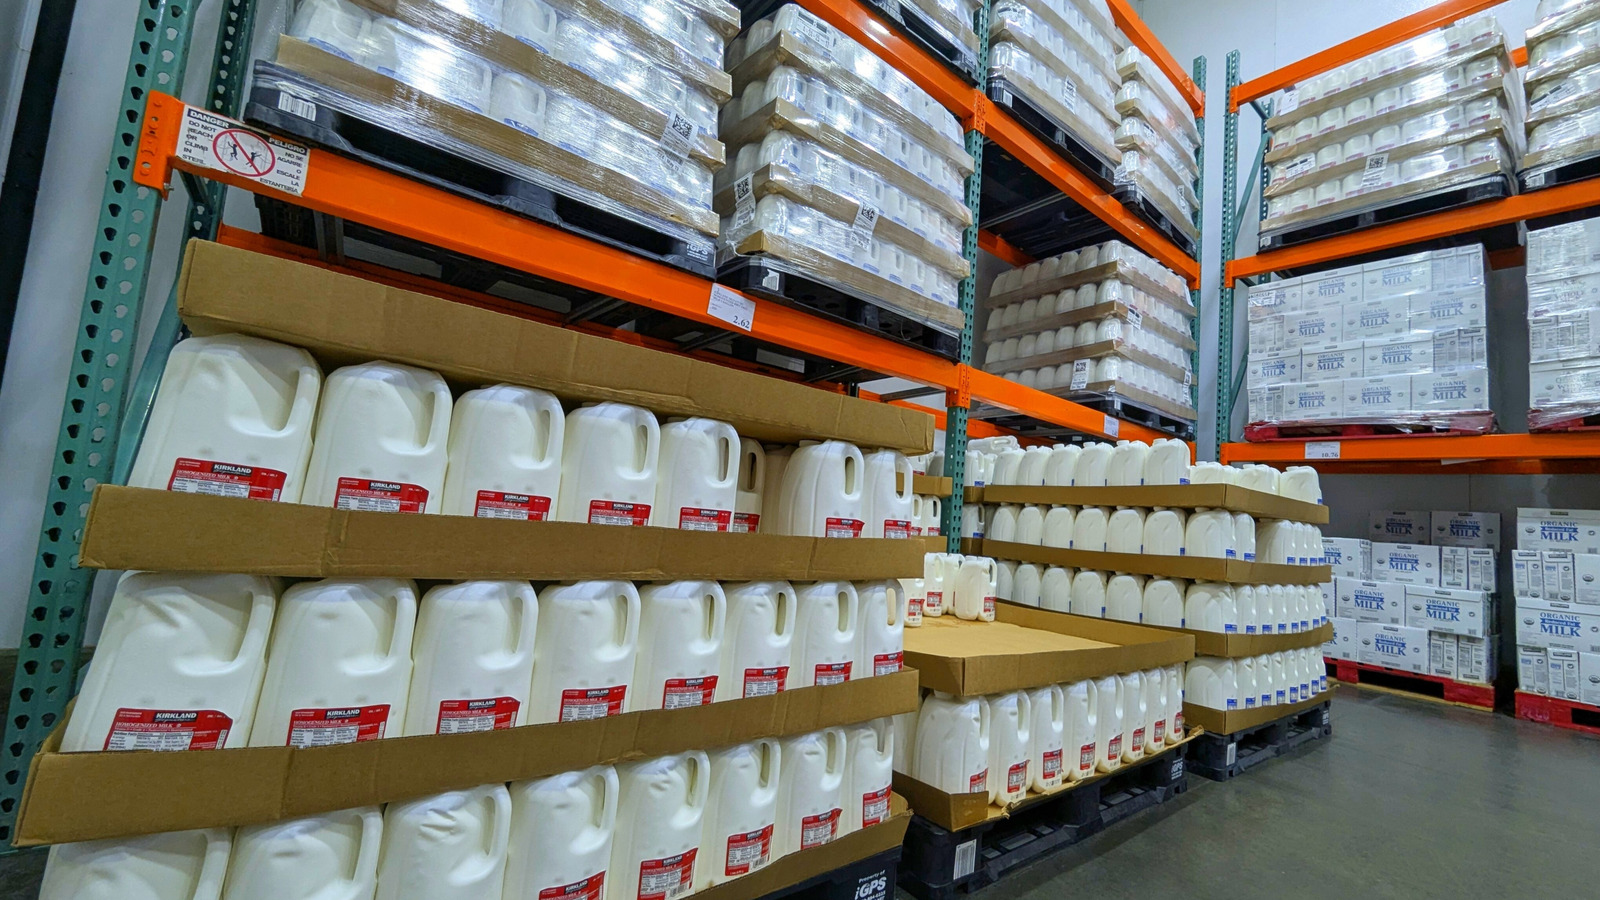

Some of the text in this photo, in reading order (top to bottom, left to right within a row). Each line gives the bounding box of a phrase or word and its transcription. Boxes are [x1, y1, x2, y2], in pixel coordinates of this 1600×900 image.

[190, 110, 230, 129] DANGER
[188, 120, 217, 133] DO NOT
[186, 134, 198, 142] OR
[187, 127, 213, 139] REACH
[184, 140, 209, 152] CLIMB
[268, 137, 307, 154] PELIGRO
[277, 156, 303, 168] AGARRE
[285, 151, 304, 162] NO SE
[276, 169, 301, 181] ESCALE
[1382, 275, 1412, 287] MILK
[1318, 286, 1345, 298] MILK
[1430, 308, 1464, 319] MILK
[733, 315, 750, 329] 2.62
[1360, 317, 1390, 328] MILK
[1299, 326, 1326, 337] MILK
[1382, 354, 1413, 365] MILK
[1317, 361, 1345, 371] MILK
[1261, 368, 1286, 378] MILK
[1361, 395, 1392, 405] MILK
[1432, 391, 1467, 401] MILK
[1298, 399, 1325, 409] MILK
[214, 463, 252, 474] KIRKLAND
[370, 482, 401, 490] KIRKLAND
[1385, 527, 1413, 535] MILK
[1449, 529, 1480, 537] MILK
[1540, 531, 1578, 541] MILK
[1324, 556, 1342, 565] ILK
[1389, 562, 1419, 571] MILK
[1354, 589, 1384, 597] ORGANIC
[1354, 600, 1385, 610] MILK
[1426, 599, 1460, 607] ORGANIC
[1426, 610, 1460, 621] MILK
[1540, 612, 1581, 621] ORGANIC
[1540, 624, 1581, 637] MILK
[1375, 633, 1405, 642] ORGANIC
[1375, 644, 1406, 656] MILK
[859, 873, 879, 884] Property
[566, 880, 588, 891] KIRKLAND
[854, 876, 887, 900] iGPS
